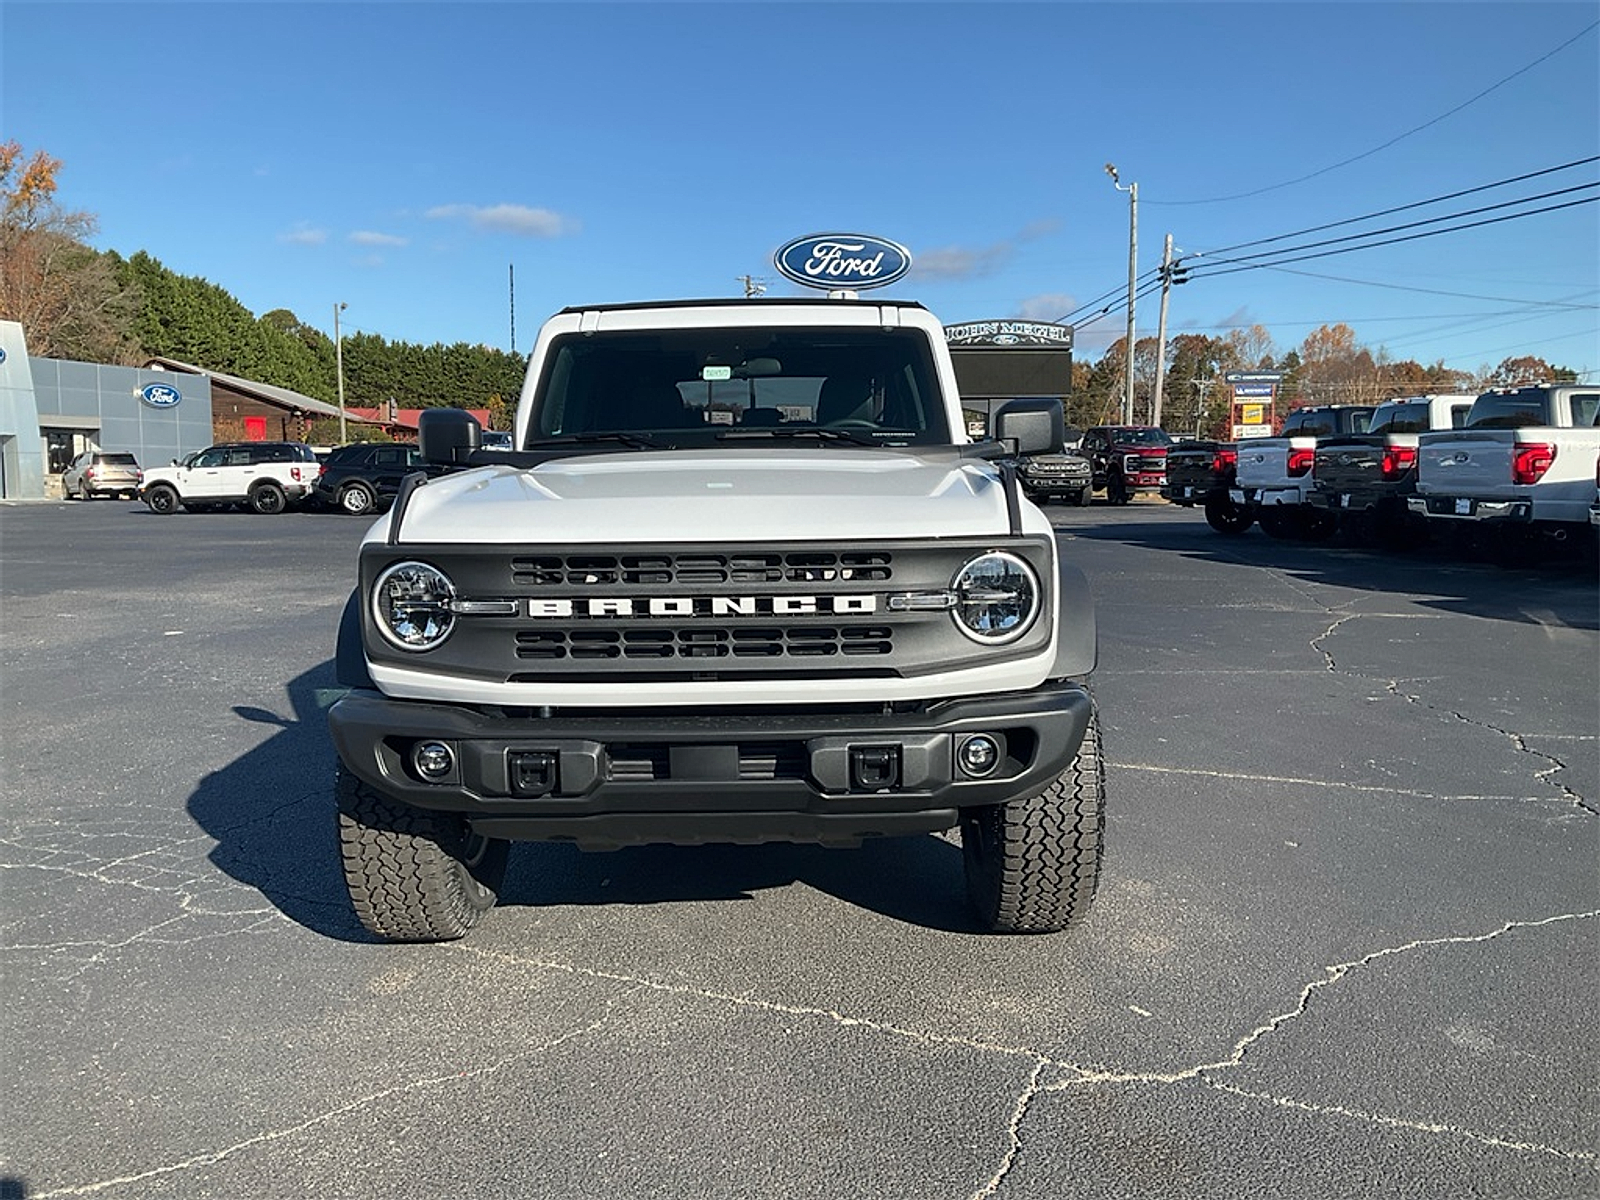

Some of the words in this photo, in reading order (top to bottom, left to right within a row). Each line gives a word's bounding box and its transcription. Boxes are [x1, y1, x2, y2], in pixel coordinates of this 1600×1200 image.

[805, 242, 884, 276] Ford
[945, 322, 999, 341] JOHN
[1000, 322, 1070, 342] MEGEL
[150, 388, 175, 403] Ford
[528, 594, 877, 617] BRONCO
